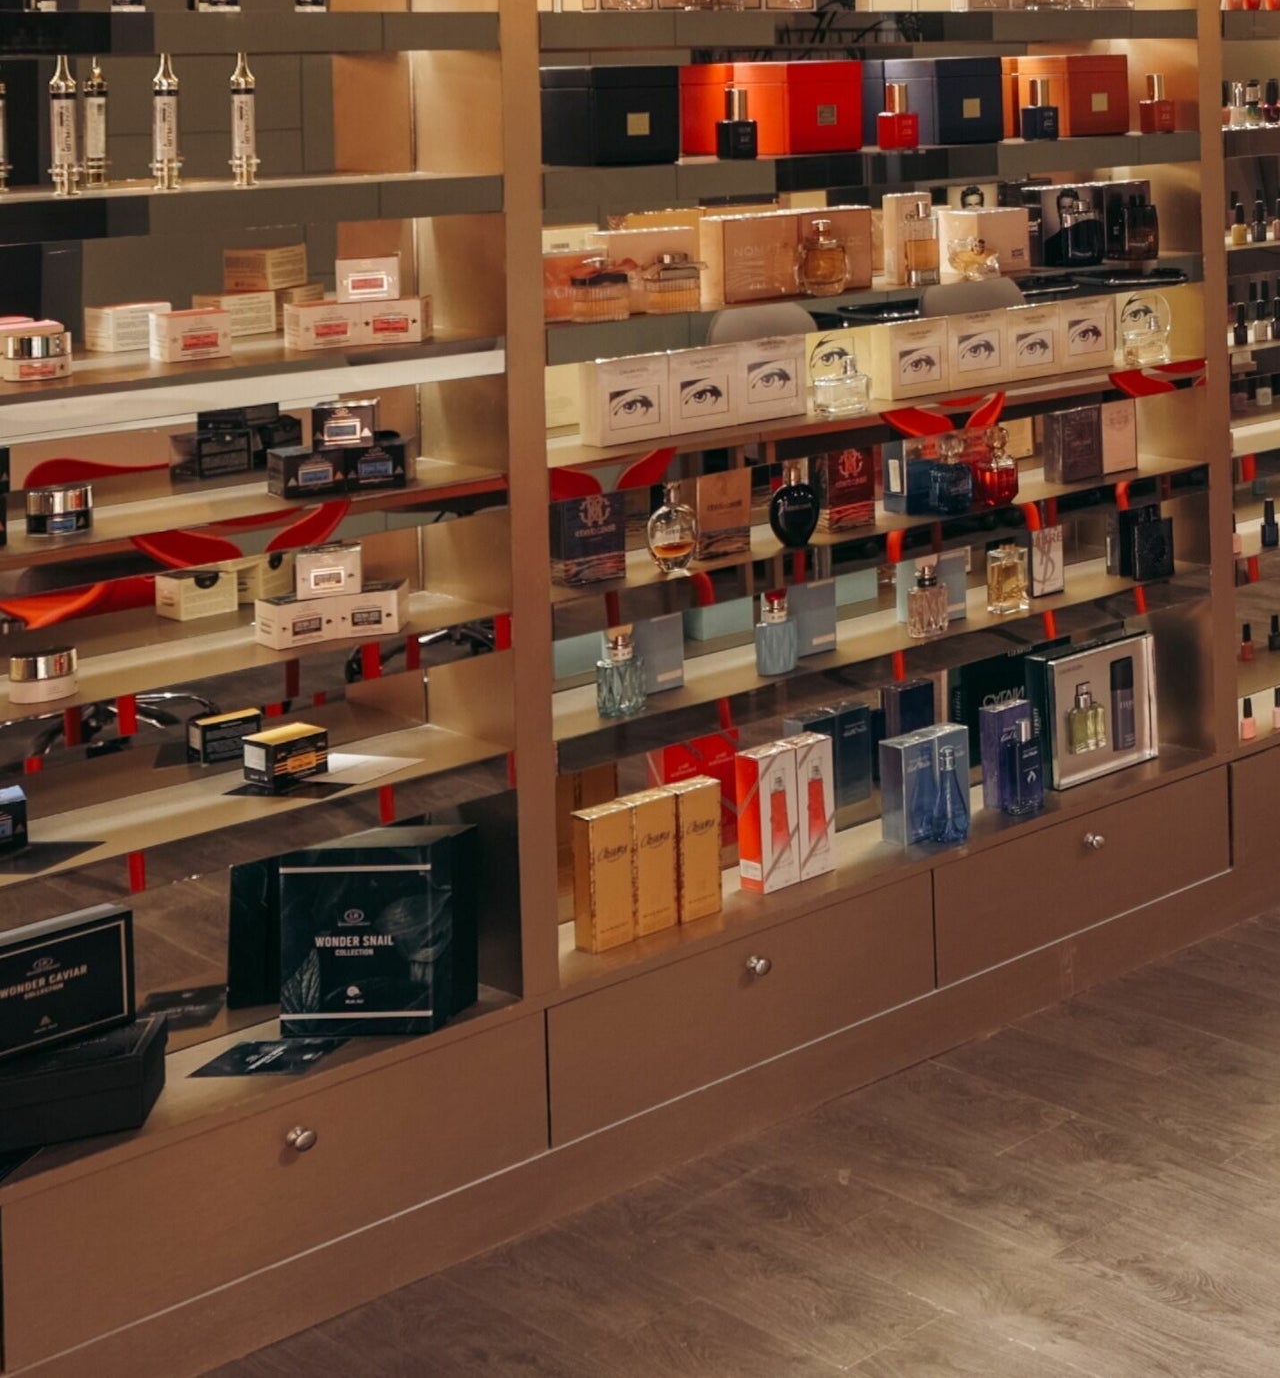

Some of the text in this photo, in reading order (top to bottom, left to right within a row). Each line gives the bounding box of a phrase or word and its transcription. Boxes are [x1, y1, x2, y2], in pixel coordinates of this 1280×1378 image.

[315, 935, 394, 947] WONDER SNAIL
[0, 977, 46, 999] WONDER
[49, 964, 88, 983] CAVIAR
